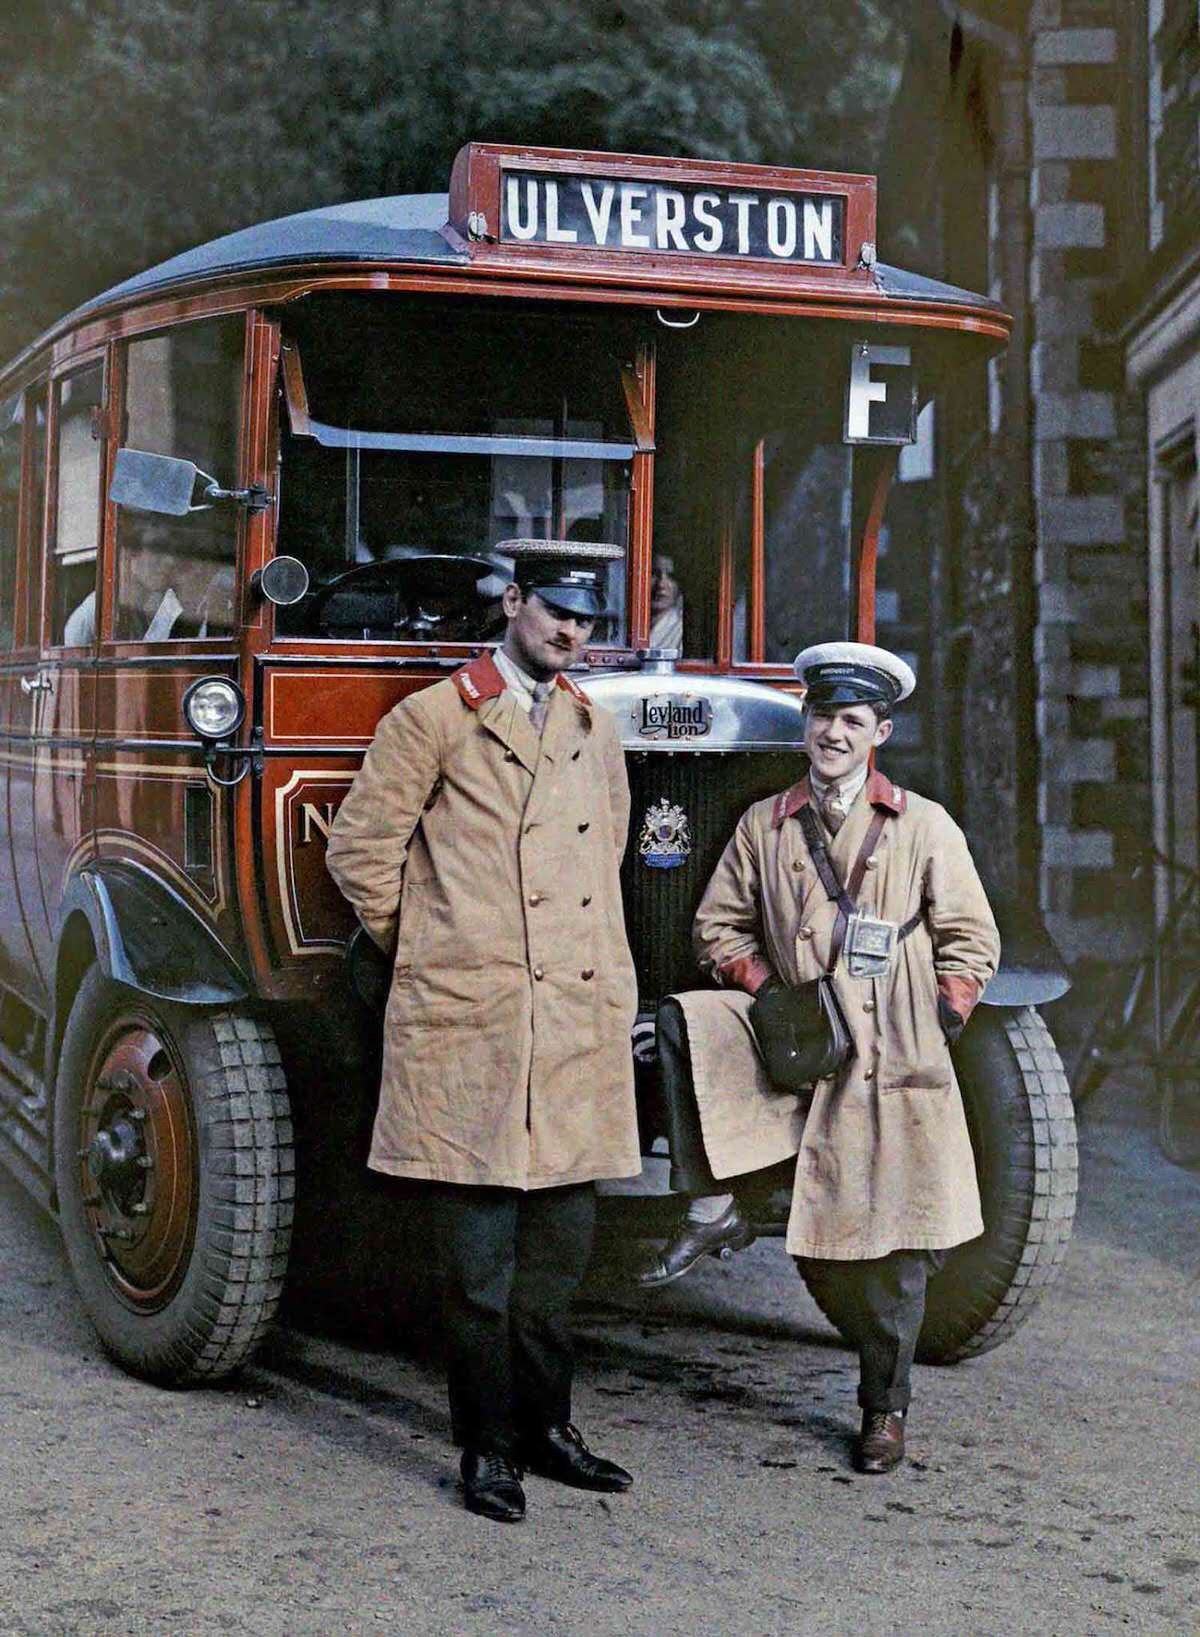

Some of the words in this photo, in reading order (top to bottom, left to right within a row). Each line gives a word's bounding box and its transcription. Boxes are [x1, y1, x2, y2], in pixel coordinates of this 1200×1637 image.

[507, 176, 833, 261] ULVERSTON
[640, 698, 703, 730] Leyland
[667, 723, 702, 739] Lion
